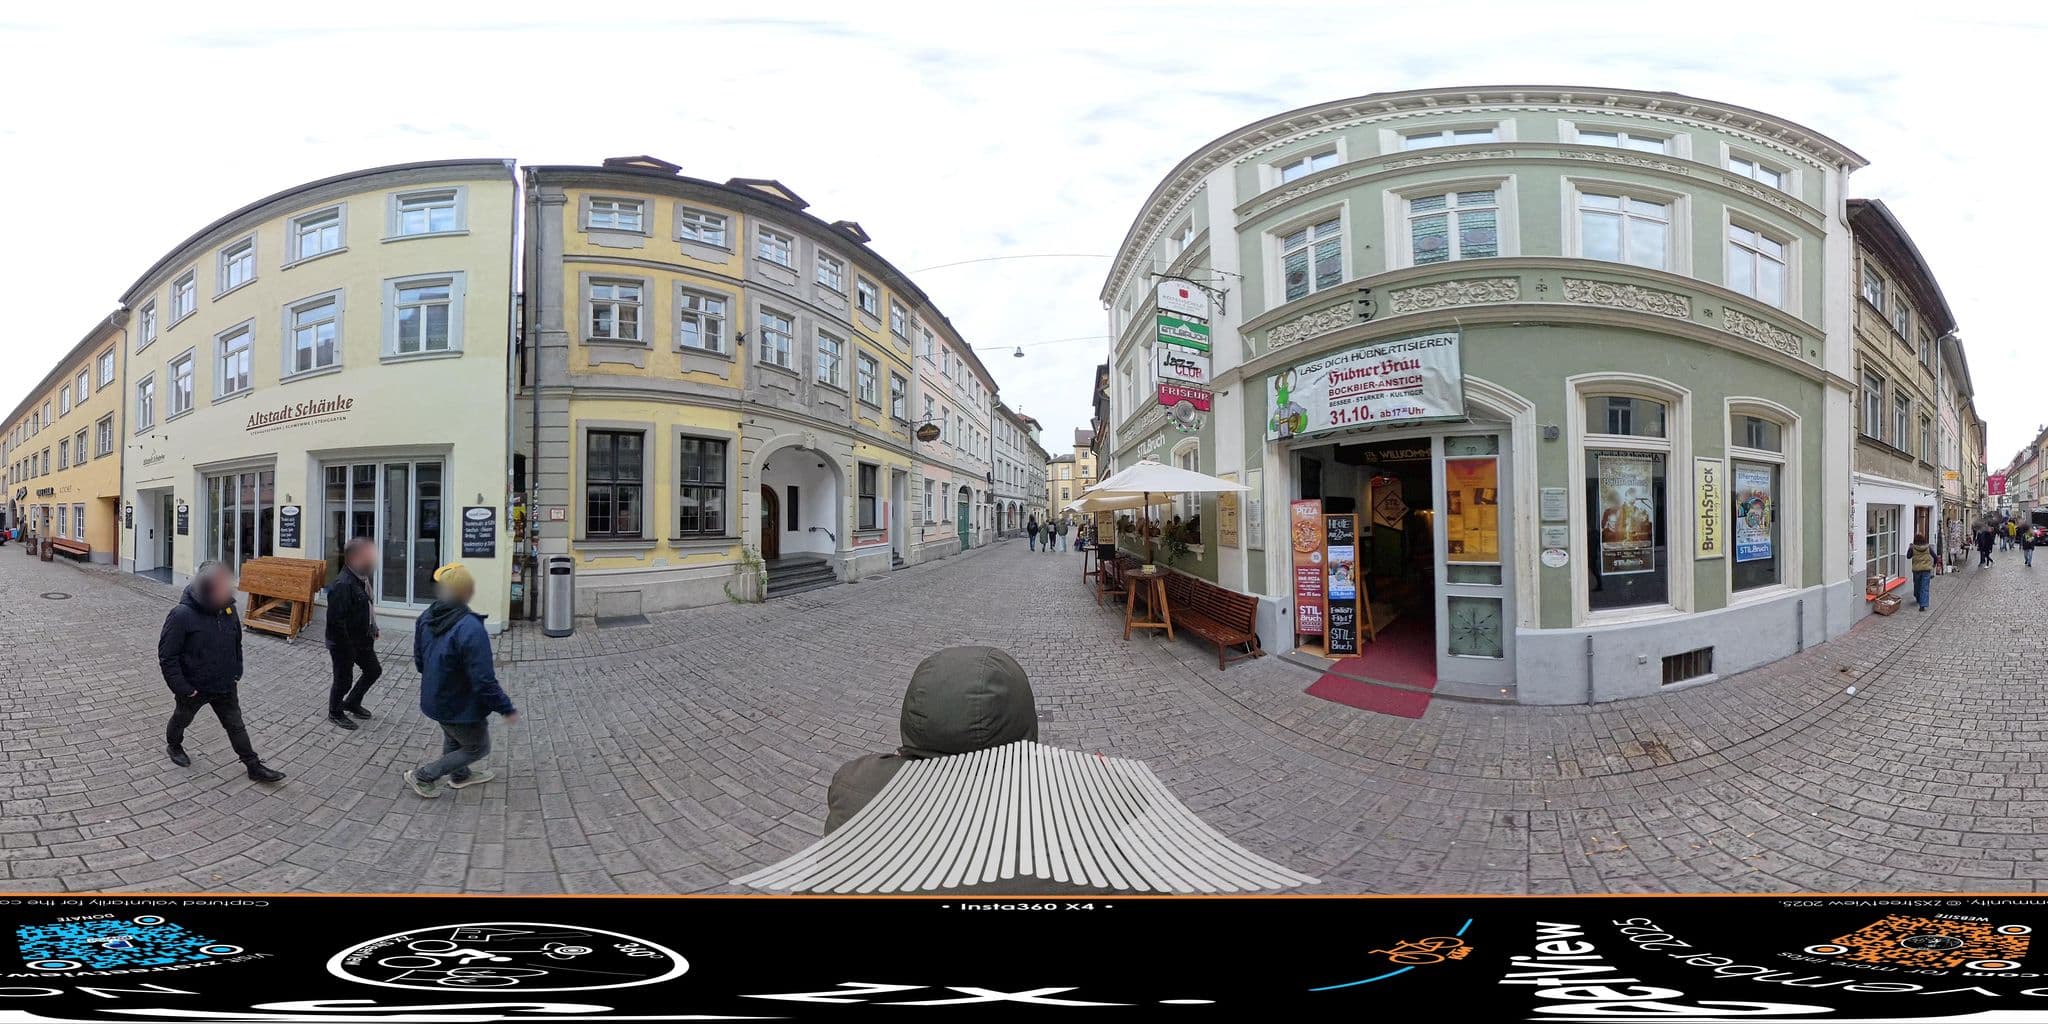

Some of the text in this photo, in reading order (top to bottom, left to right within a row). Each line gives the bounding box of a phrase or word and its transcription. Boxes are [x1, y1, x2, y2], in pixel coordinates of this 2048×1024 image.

[1300, 362, 1323, 376] LASS
[1325, 356, 1349, 368] DICH
[1161, 386, 1209, 401] FRISEUR
[1328, 375, 1423, 397] BOCKBIER-ANSTICH
[247, 395, 354, 427] Altstadt Schänke
[1330, 405, 1374, 425] 31.10.
[1408, 406, 1425, 416] Uhr
[1296, 507, 1318, 516] PIZZA
[1300, 614, 1322, 622] Bruch
[1331, 640, 1352, 650] Bruch
